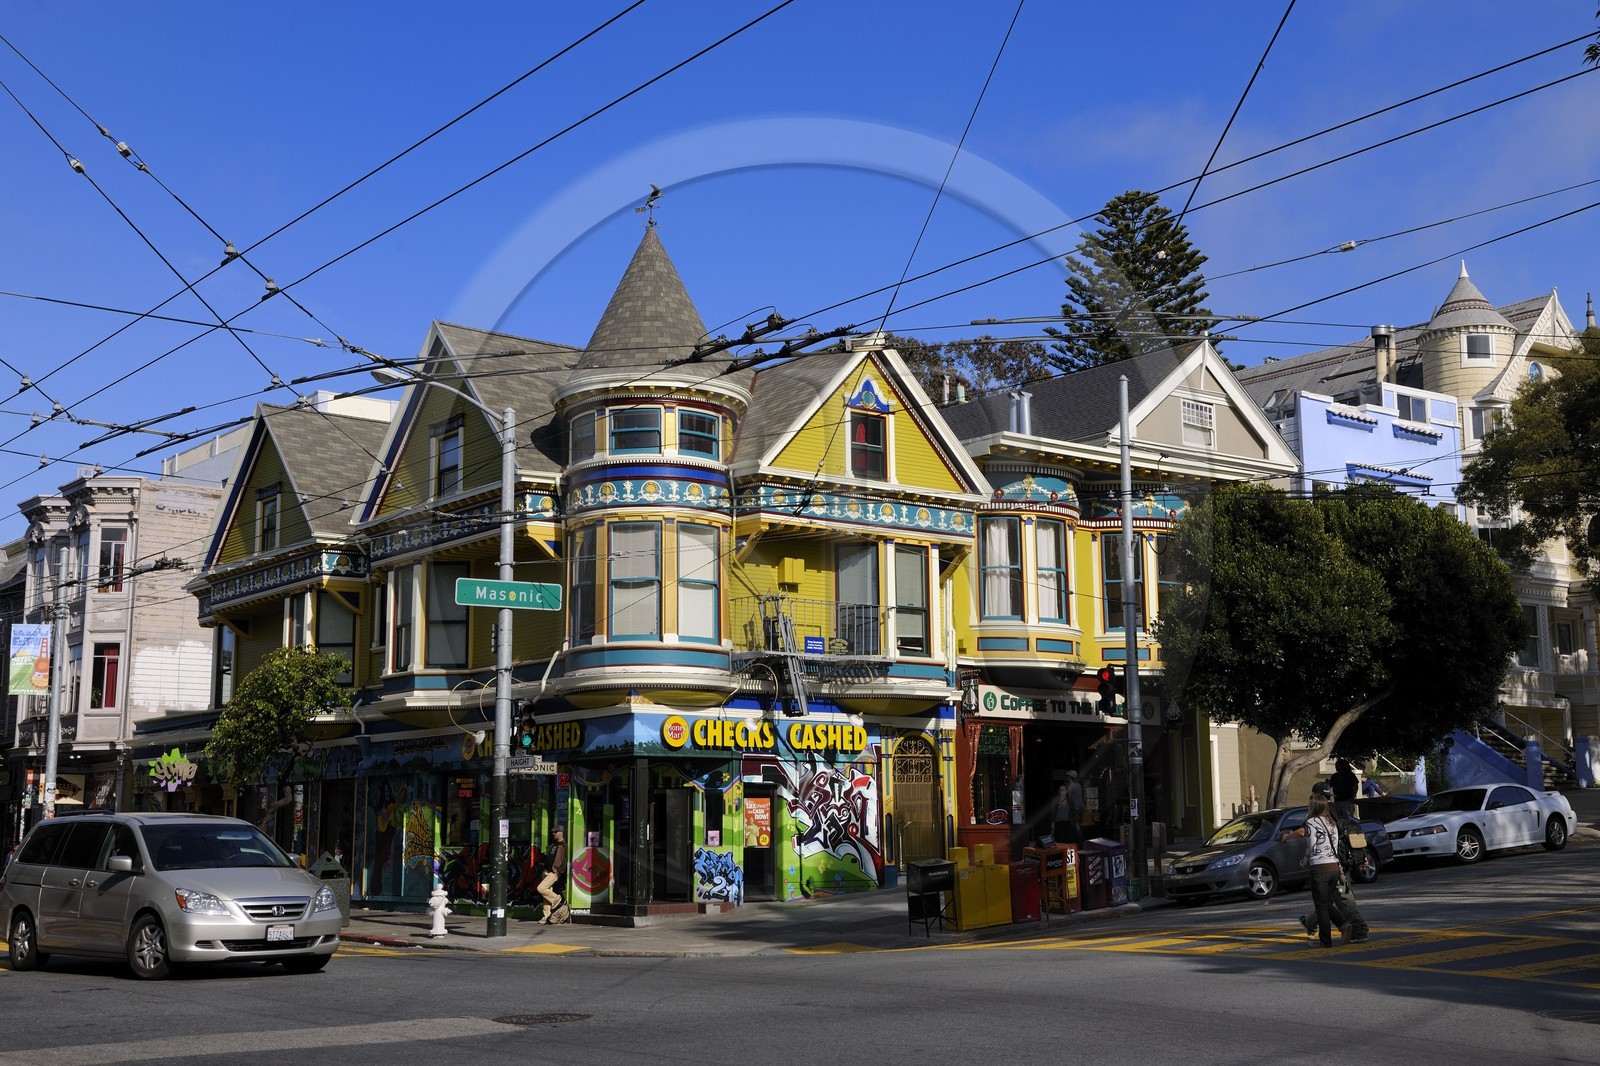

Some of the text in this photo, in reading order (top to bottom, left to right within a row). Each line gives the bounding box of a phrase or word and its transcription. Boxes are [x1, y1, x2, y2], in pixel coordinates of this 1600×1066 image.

[475, 585, 543, 603] Masonic
[1049, 700, 1067, 714] TO
[1069, 700, 1093, 715] THE
[666, 722, 687, 732] Money
[667, 730, 685, 740] Mart
[693, 718, 868, 752] CHECKS CASHED
[510, 757, 530, 766] HAIGHT
